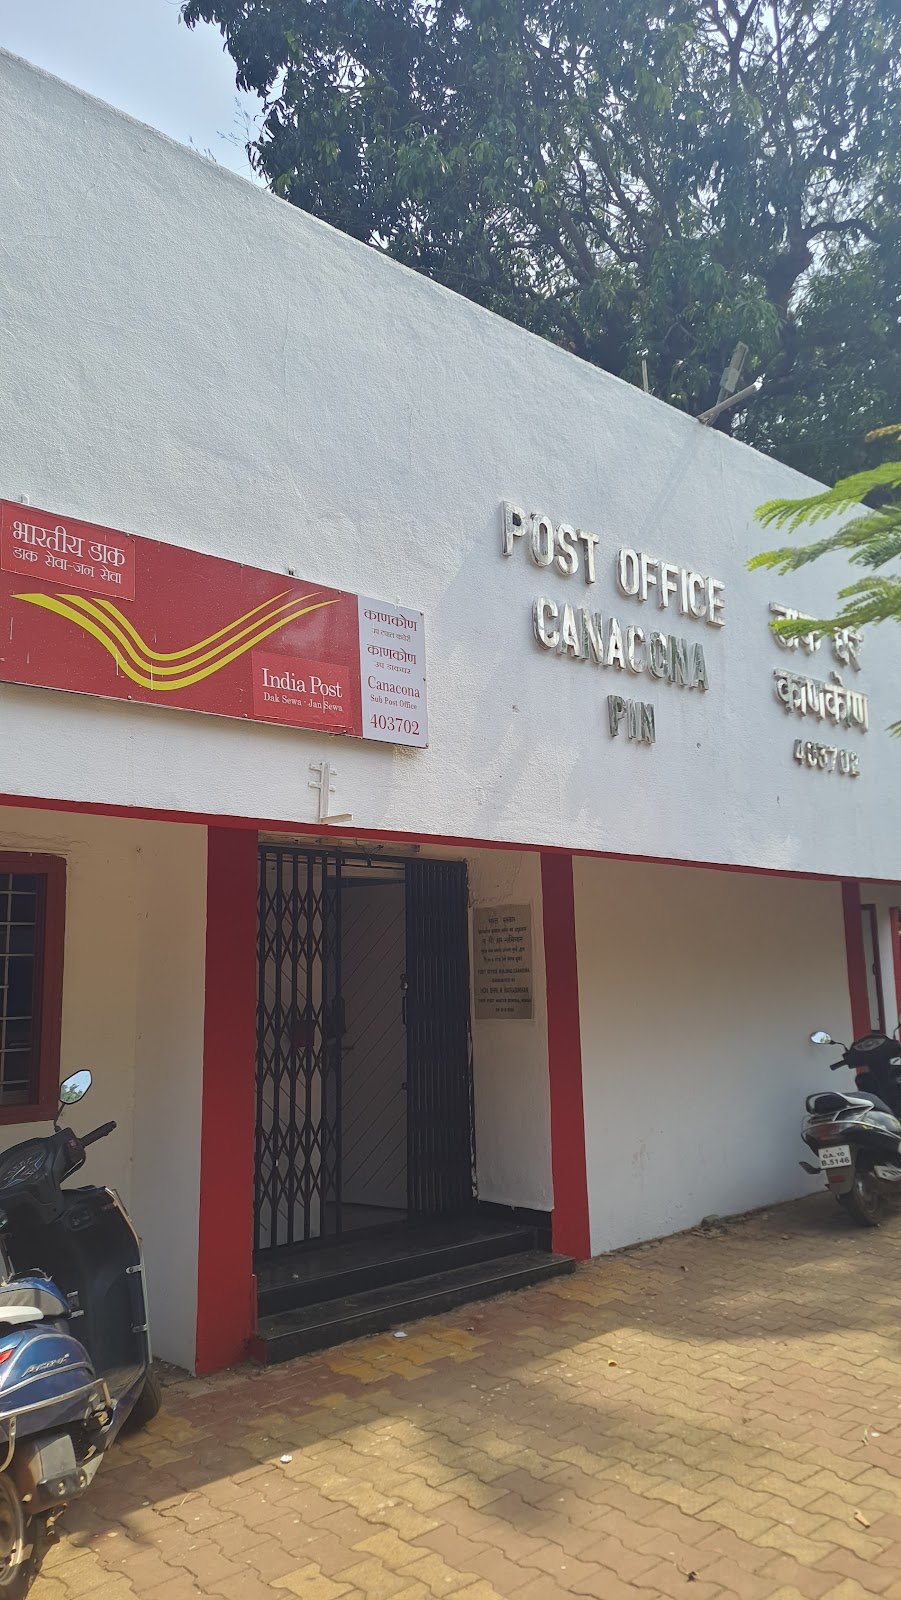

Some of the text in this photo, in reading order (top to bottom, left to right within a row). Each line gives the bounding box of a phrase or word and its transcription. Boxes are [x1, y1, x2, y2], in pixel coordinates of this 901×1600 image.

[13, 521, 125, 566] भारतीय डाक
[13, 547, 38, 562] डाक
[100, 565, 122, 584] सेवा
[500, 500, 726, 628] POST OFFICE
[363, 609, 417, 631] काणकोण
[366, 644, 416, 664] काणकोण
[532, 596, 709, 691] CANACONA
[262, 668, 343, 698] India Post
[368, 676, 420, 698] Canacona
[264, 692, 280, 703] Dak
[281, 695, 302, 706] Sewa
[308, 699, 322, 709] Jan
[323, 701, 343, 711] Sewa
[370, 695, 417, 710] Sub Post Office
[773, 668, 869, 733] काणकोण
[370, 713, 420, 736] 403702
[607, 694, 656, 744] PIN
